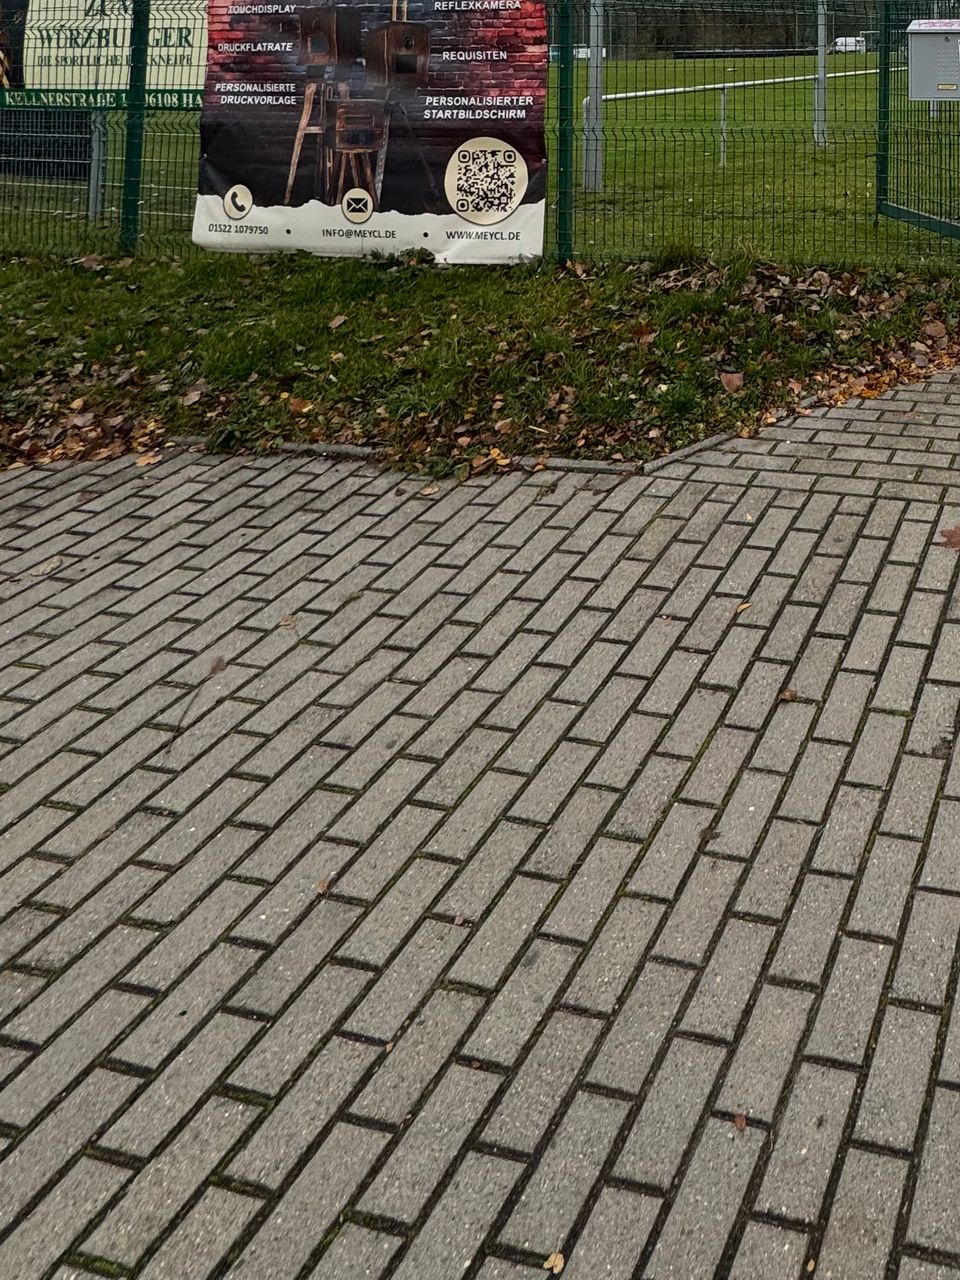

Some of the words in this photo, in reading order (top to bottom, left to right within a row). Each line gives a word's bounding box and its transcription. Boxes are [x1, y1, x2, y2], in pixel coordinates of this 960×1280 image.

[228, 4, 297, 15] TOUCHDISPLAY
[434, 0, 522, 11] REFLEXKAMERA
[38, 24, 193, 48] WÜRZBUGER
[218, 42, 293, 53] DRUCKFLATRATE
[442, 51, 508, 61] REQUISITEN
[215, 83, 296, 93] PERSONALISIERTE
[220, 95, 297, 106] DRUCKVORLAGE
[425, 95, 534, 107] PERSONALISIERTER
[423, 109, 526, 120] STARTBILDSCHIRM
[208, 223, 232, 234] 01522
[232, 224, 269, 236] 1079750
[321, 228, 397, 240] INFO@MEYCL.DE
[445, 230, 521, 242] WWW.MEYCL.DE
